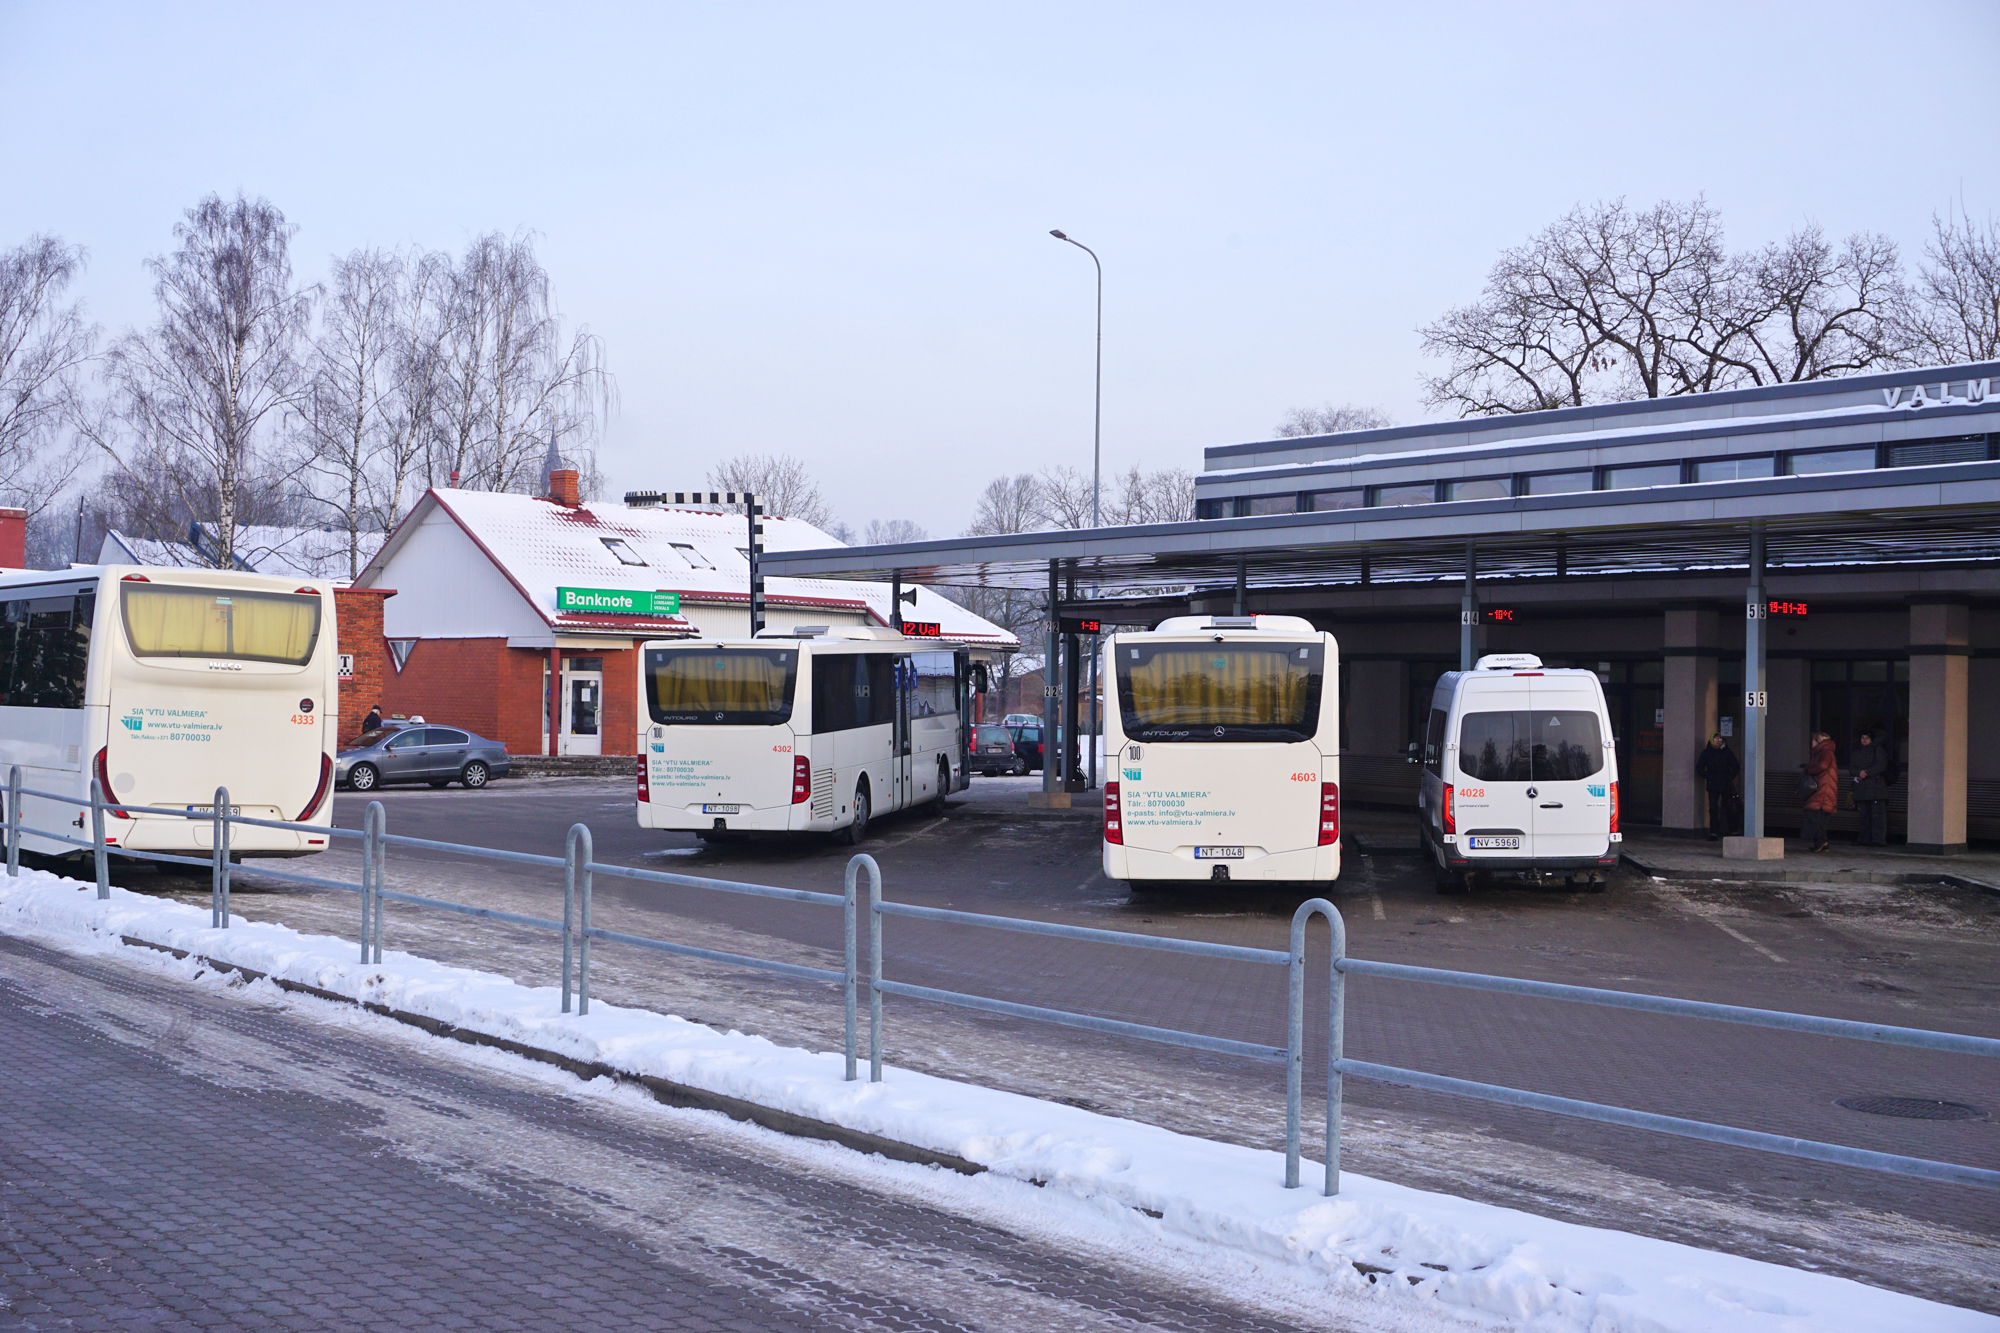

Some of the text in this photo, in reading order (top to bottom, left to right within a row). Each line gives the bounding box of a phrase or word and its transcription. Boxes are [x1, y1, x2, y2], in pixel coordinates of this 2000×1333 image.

[1882, 378, 1991, 408] VALM
[565, 591, 633, 607] Banknote
[1749, 604, 1765, 618] 5 5
[1769, 601, 1807, 615] 19-01-26
[1463, 611, 1478, 625] 4 4
[1488, 609, 1513, 620] -10°C
[919, 623, 940, 636] Val
[1046, 621, 1058, 632] 2 2
[209, 662, 243, 671] IVECO
[340, 655, 350, 668] T
[1045, 686, 1057, 697] 2 2
[1748, 693, 1764, 706] 5 5
[167, 710, 208, 718] VALMIERA"
[291, 715, 315, 725] 4333
[147, 722, 223, 730] www.vtu-valmiera.lv
[170, 733, 211, 742] 80700030
[653, 727, 663, 739] 100
[772, 745, 792, 753] 4302
[1128, 746, 1141, 760] 100
[1290, 772, 1317, 782] 4603
[1459, 788, 1485, 797] 4028
[1159, 810, 1236, 818] info@vtu-valmiera.lv
[1476, 838, 1518, 847] NV-5968
[1201, 848, 1243, 856] NT-1048
